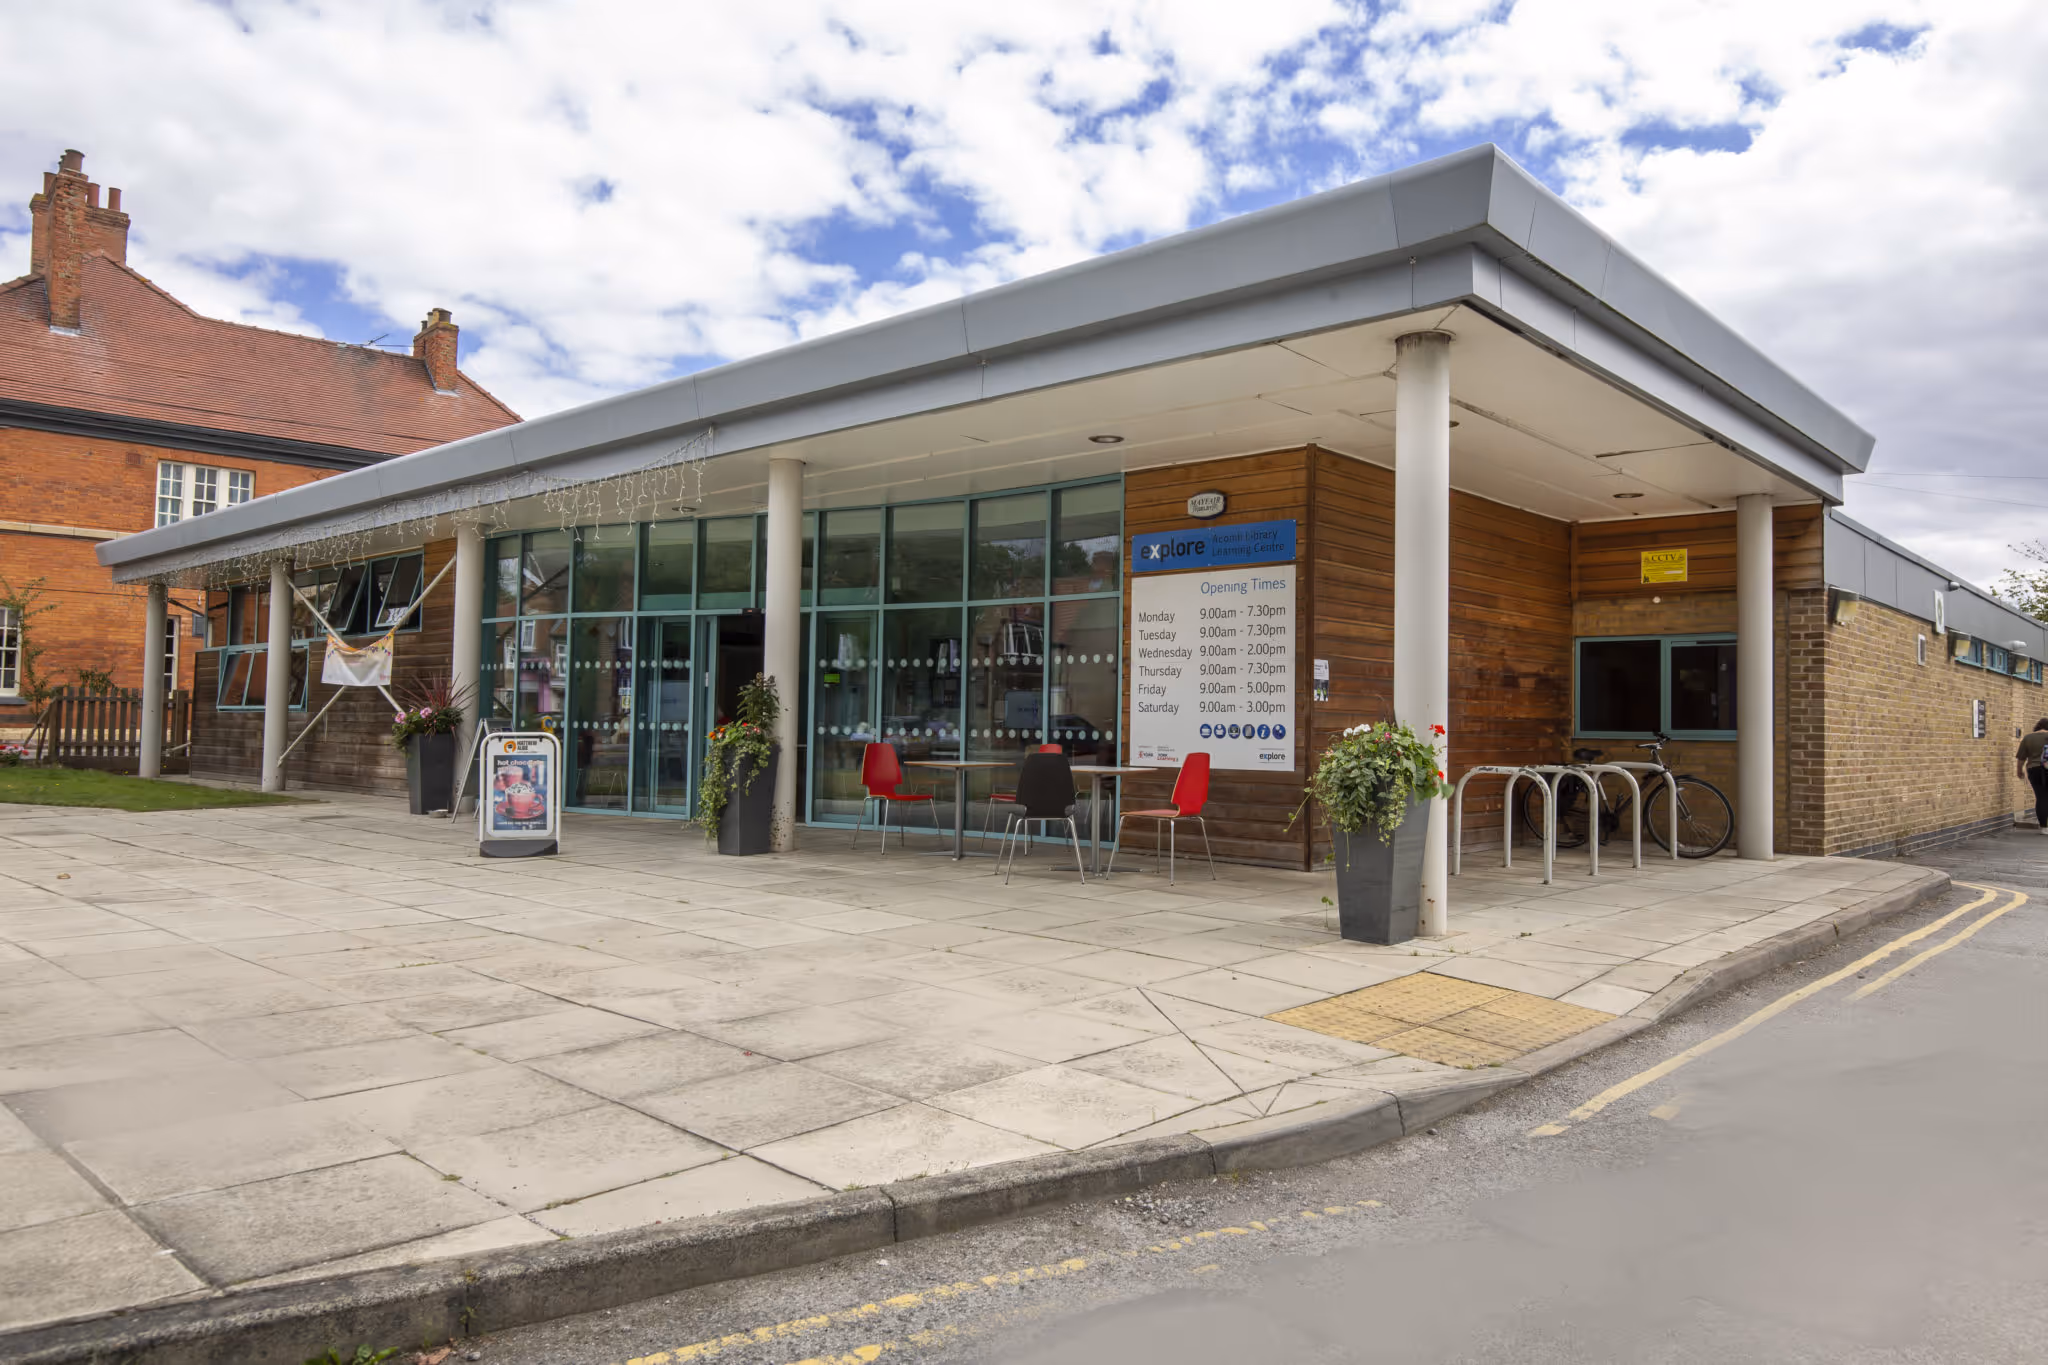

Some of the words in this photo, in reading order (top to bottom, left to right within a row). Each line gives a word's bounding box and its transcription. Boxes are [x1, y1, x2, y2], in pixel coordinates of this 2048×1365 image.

[1245, 529, 1278, 541] Library
[1140, 536, 1206, 562] explore
[1212, 544, 1252, 557] Learning
[1254, 541, 1285, 553] Centre
[1651, 553, 1678, 561] CCTV
[1200, 581, 1248, 597] Opening
[1251, 577, 1286, 591] Times
[1138, 610, 1176, 624] Monday
[1199, 608, 1237, 620] 9.00am
[1247, 604, 1286, 619] 7.30pm
[1138, 627, 1177, 642] Tuesday
[1199, 626, 1237, 638] 9.00am
[1247, 624, 1286, 638] 7.30pm
[1138, 646, 1193, 660] Wednesday
[1199, 645, 1237, 656] 9.00am
[1247, 643, 1286, 657] 2.00pm
[1138, 665, 1182, 679] Thursday
[1199, 664, 1237, 676] 9.00am
[1247, 662, 1286, 676] 7.30pm
[1138, 683, 1167, 697] Friday
[1199, 682, 1237, 694] 9.00am
[1247, 681, 1286, 696] 5.00pm
[1138, 701, 1180, 716] Saturday
[1199, 701, 1237, 712] 9.00am
[1247, 700, 1286, 716] 3.00pm
[1259, 752, 1286, 761] explore
